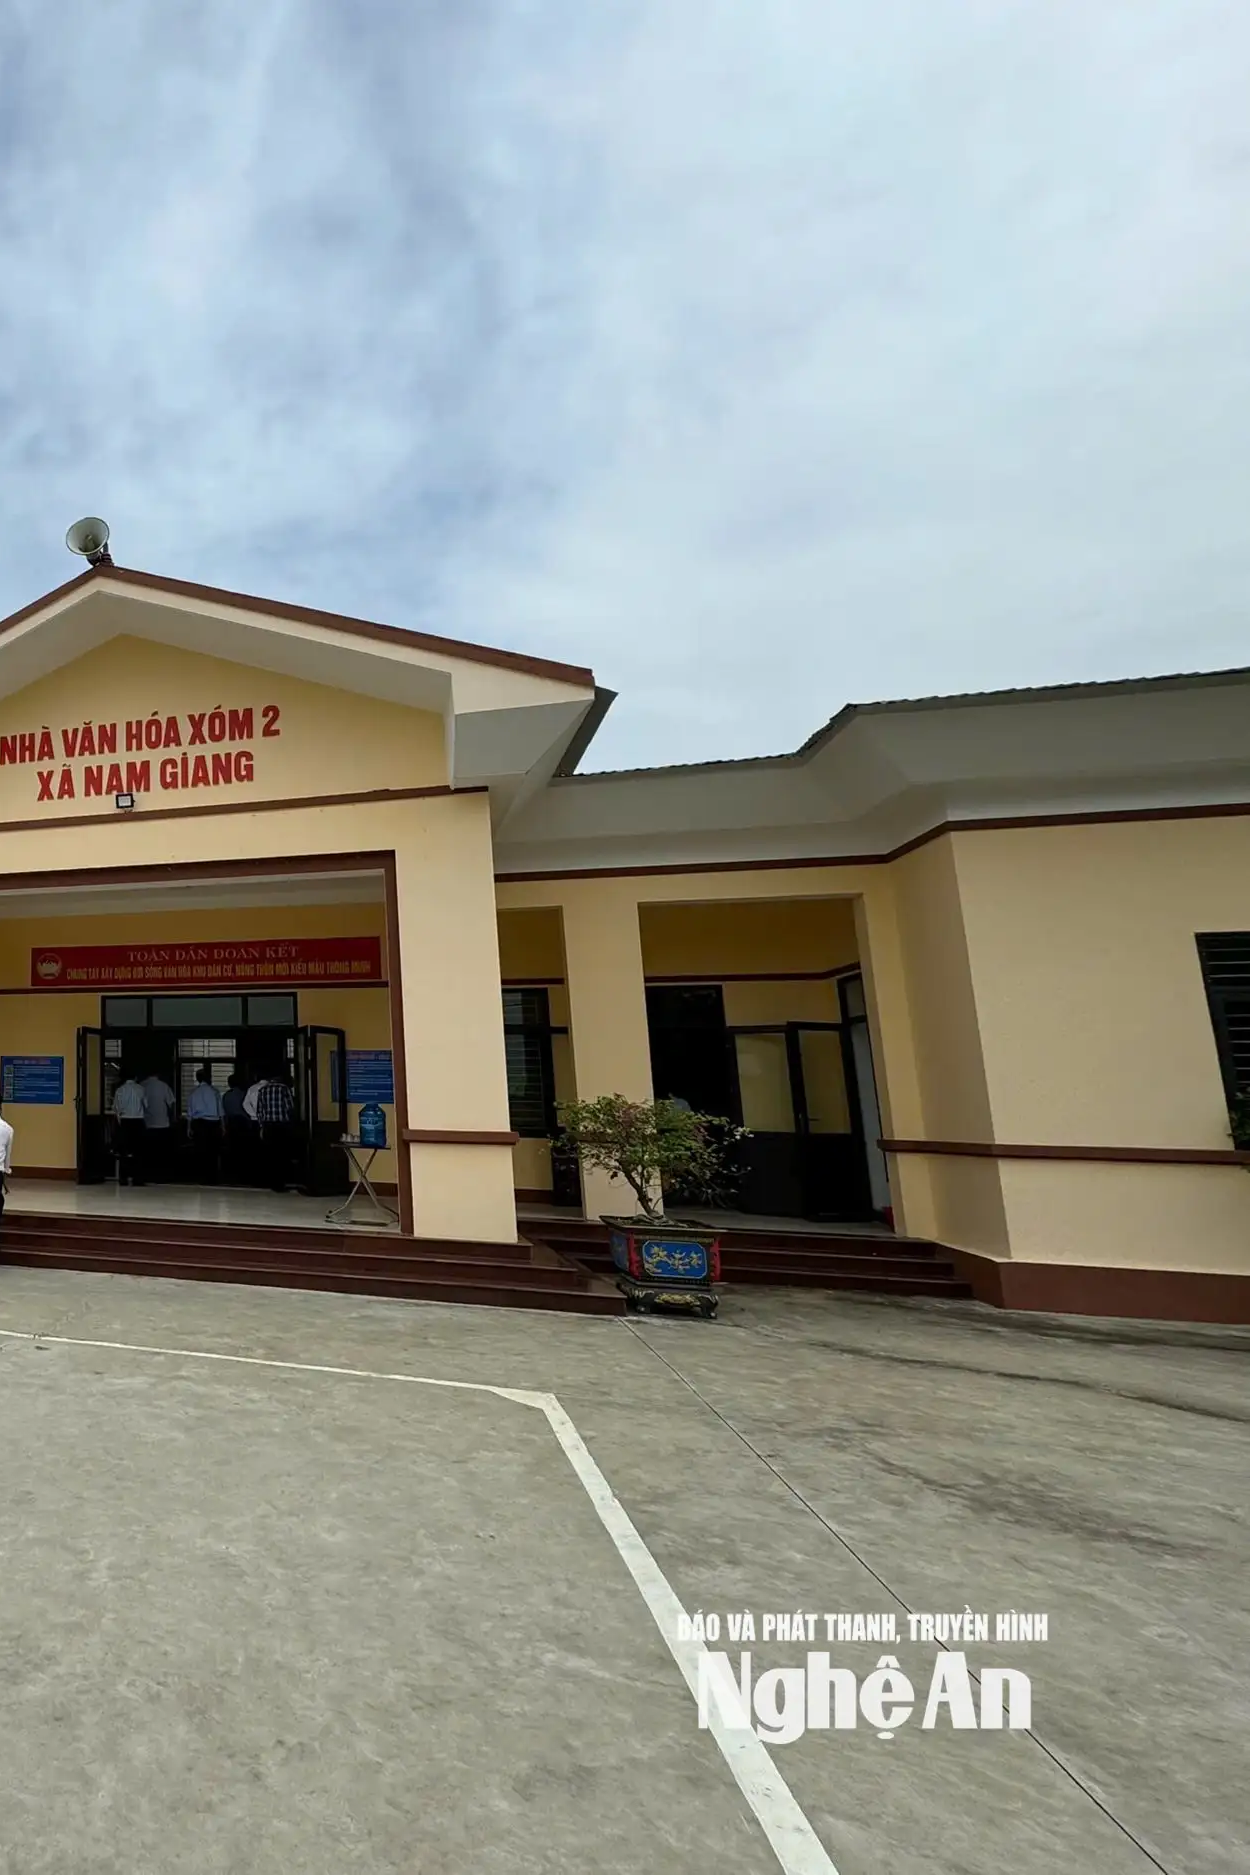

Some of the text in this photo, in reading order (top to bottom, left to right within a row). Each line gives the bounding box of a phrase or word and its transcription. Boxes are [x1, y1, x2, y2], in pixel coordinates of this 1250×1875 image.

[0, 704, 281, 765] NHÀ VĂN HÓA XÓM 2
[37, 751, 255, 801] XÃ NAM GIANG
[266, 942, 299, 958] KẾT
